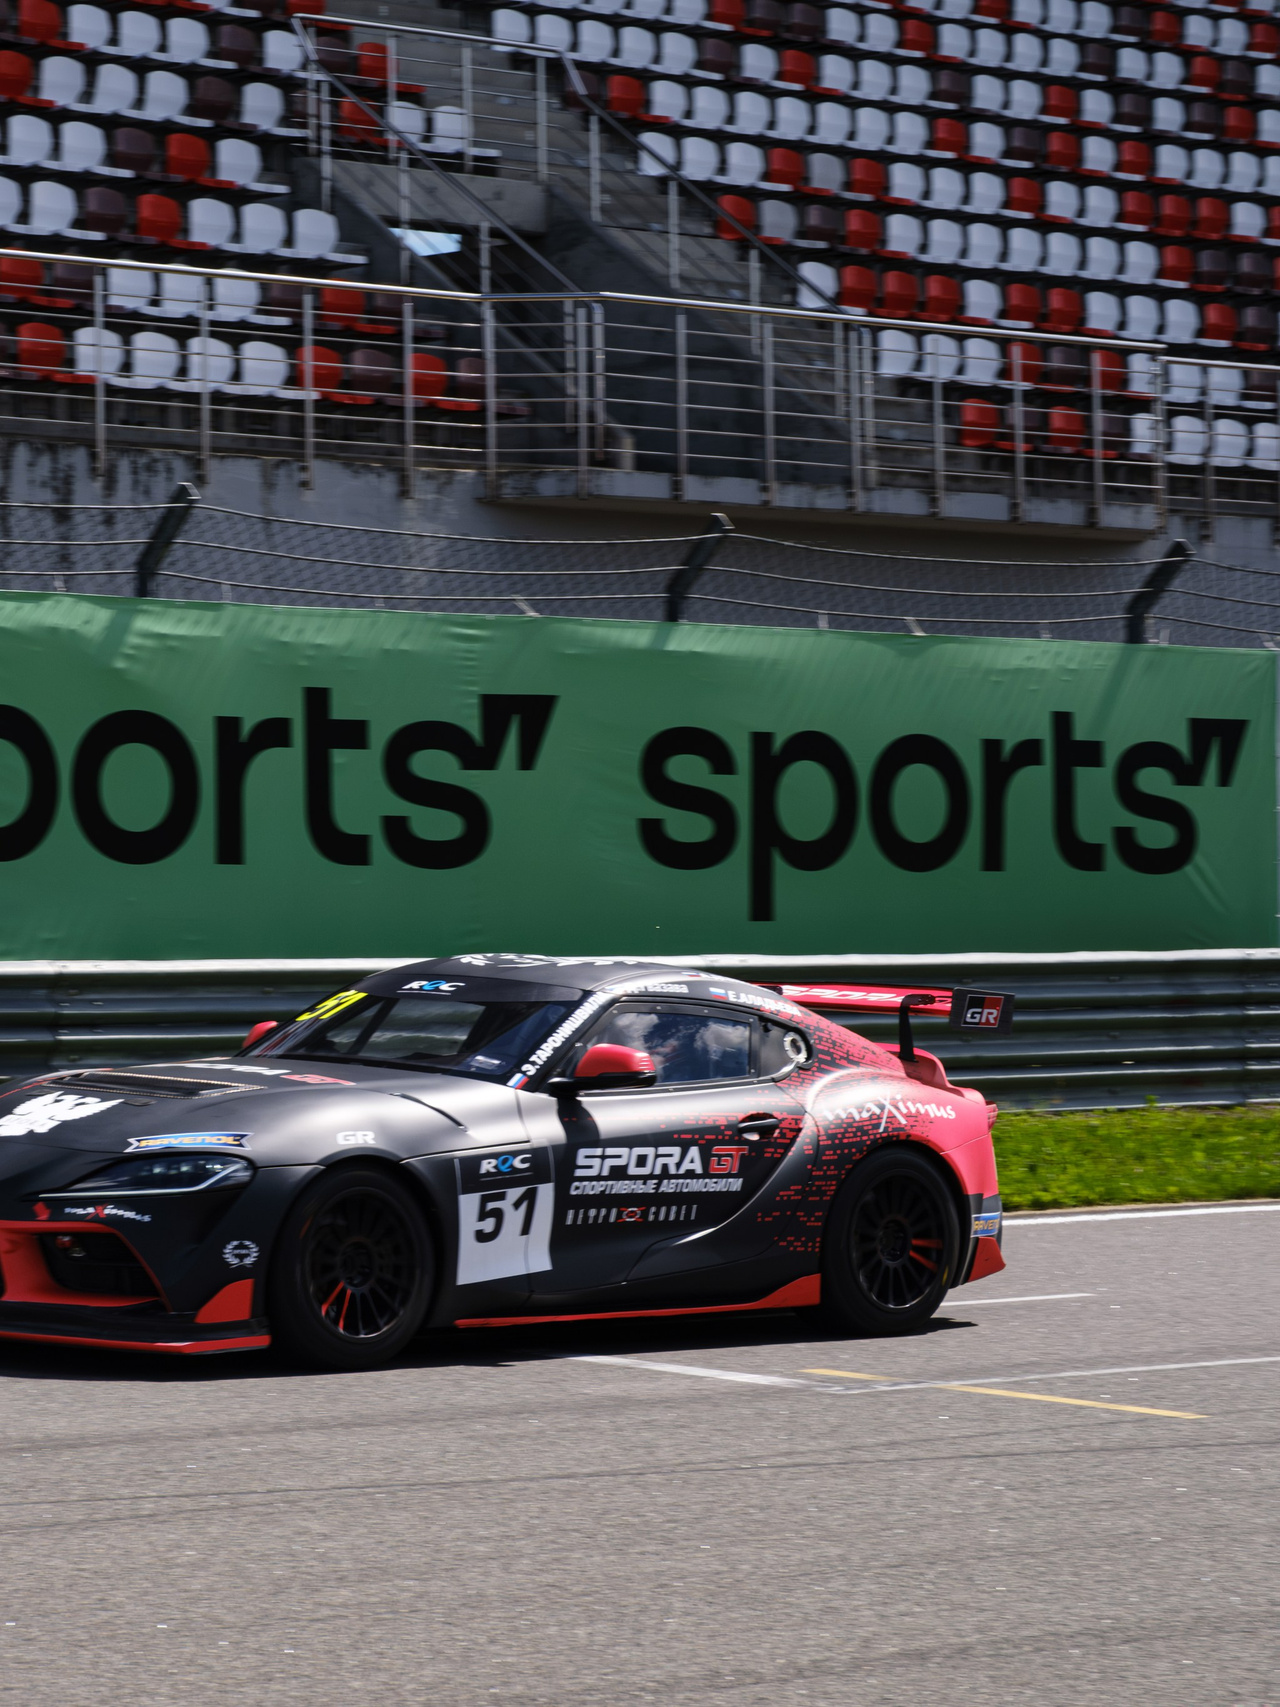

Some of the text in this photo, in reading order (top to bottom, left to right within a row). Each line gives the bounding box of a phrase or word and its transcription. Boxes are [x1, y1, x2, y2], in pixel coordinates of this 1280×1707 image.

[295, 989, 369, 1022] 51
[965, 1008, 998, 1024] GR
[138, 1134, 241, 1148] RAVENOL
[335, 1130, 376, 1145] GR
[573, 1145, 749, 1177] SPORA GT
[569, 1177, 744, 1196] СПОРТИВНЫЕ АВТОМОБИЛИ
[475, 1186, 539, 1244] 51
